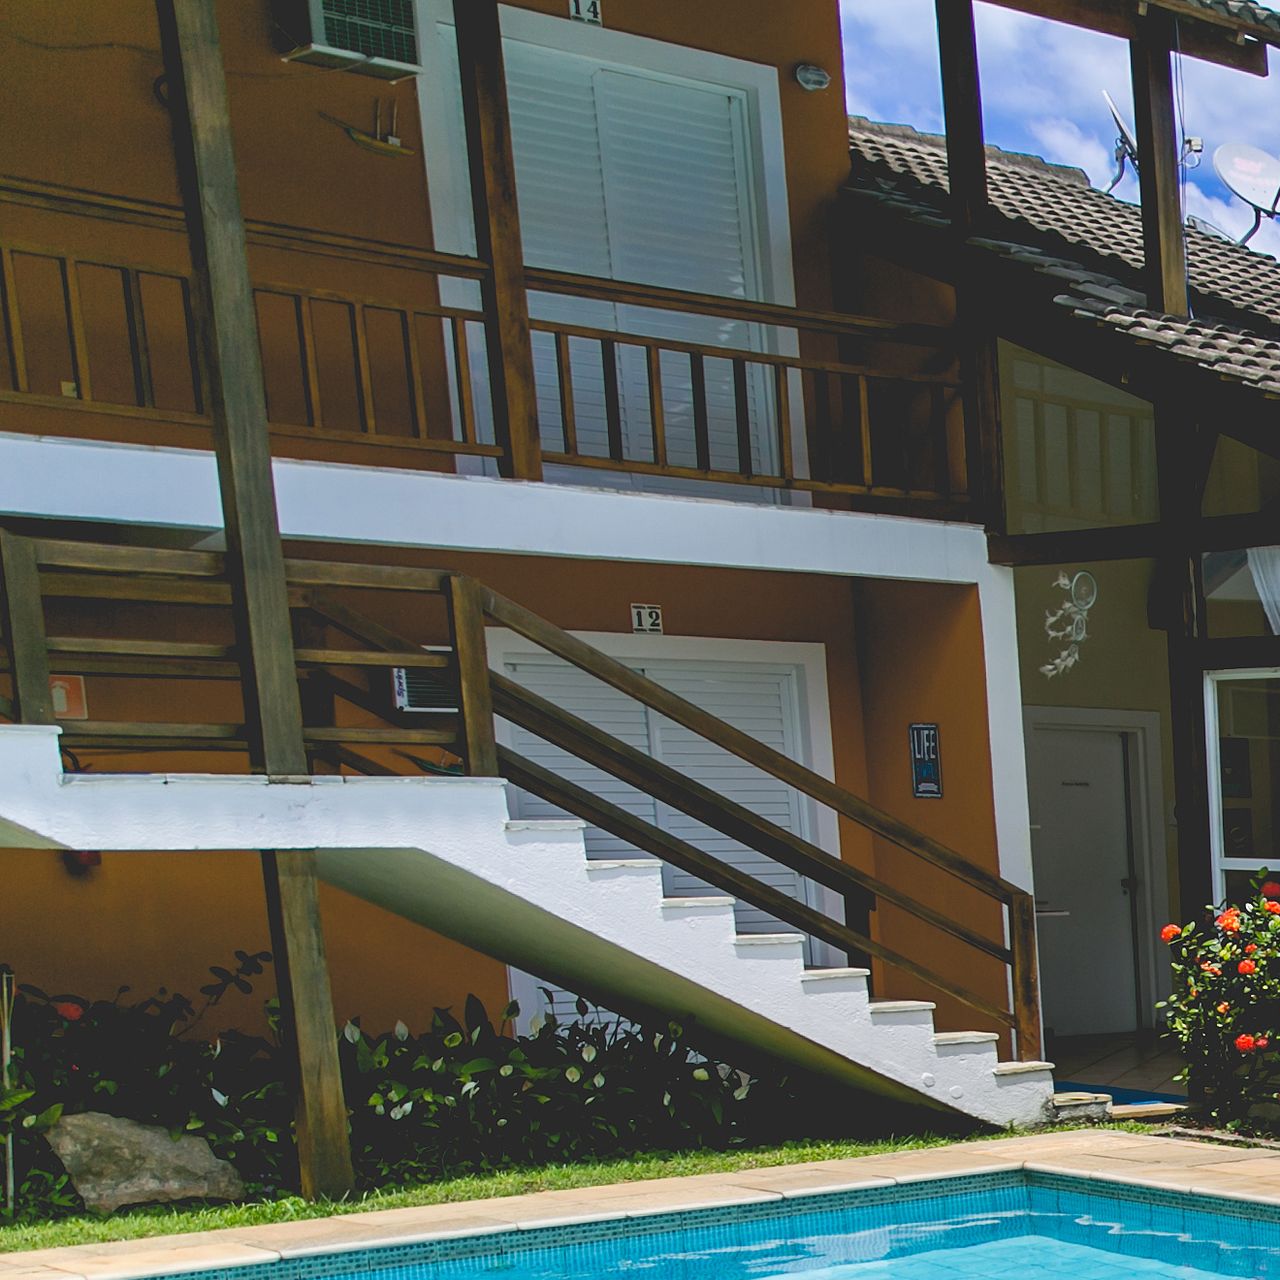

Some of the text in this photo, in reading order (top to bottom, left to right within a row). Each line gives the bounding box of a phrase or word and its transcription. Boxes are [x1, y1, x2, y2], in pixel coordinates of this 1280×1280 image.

[574, 0, 600, 19] 14
[636, 610, 661, 628] 12
[914, 730, 936, 760] LIFE
